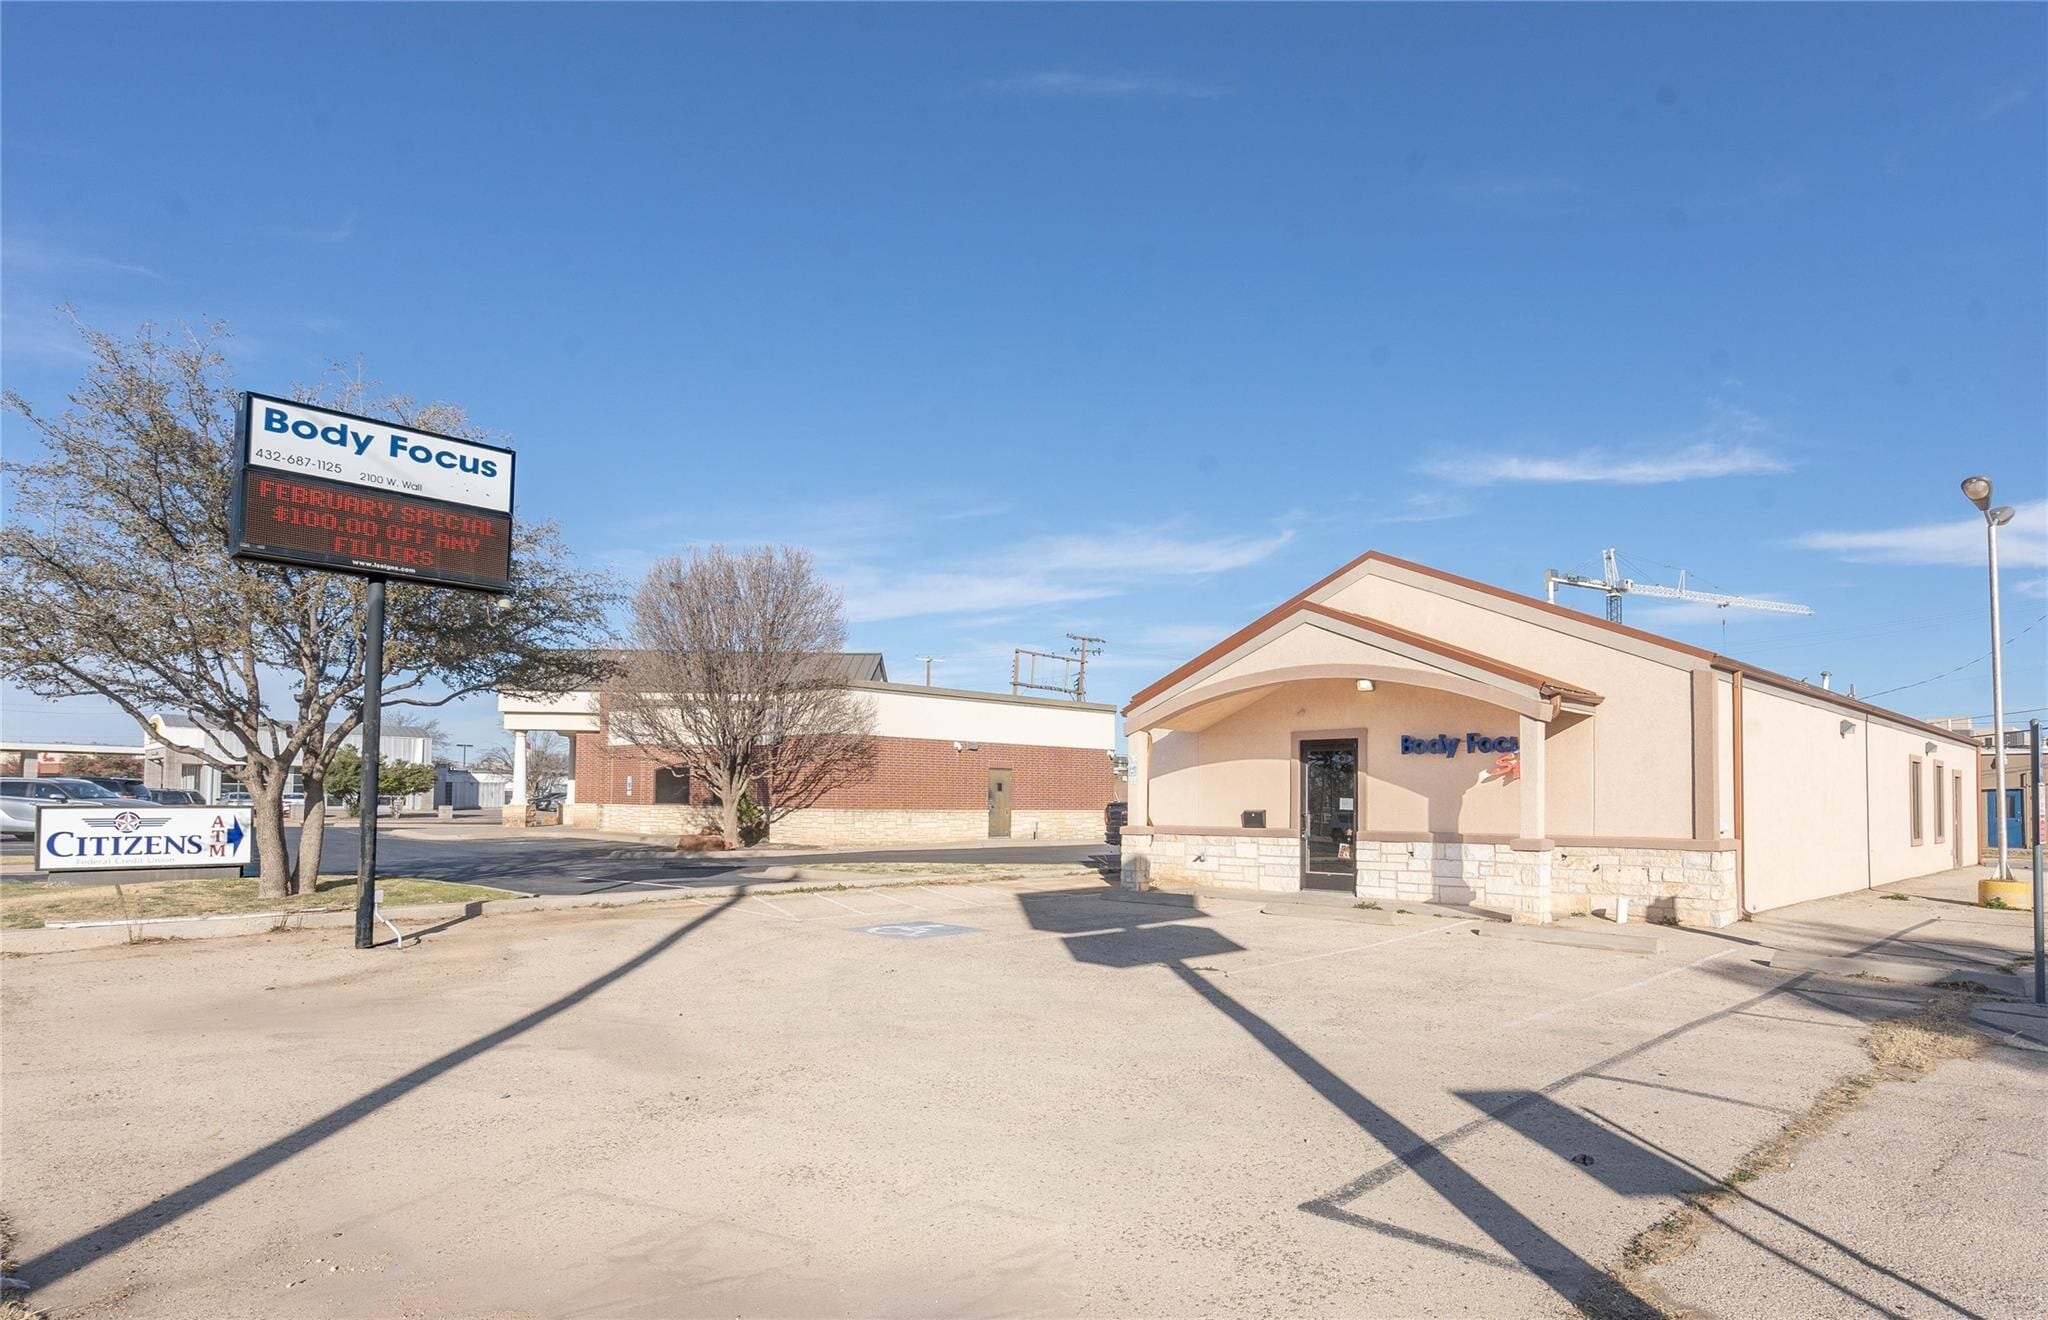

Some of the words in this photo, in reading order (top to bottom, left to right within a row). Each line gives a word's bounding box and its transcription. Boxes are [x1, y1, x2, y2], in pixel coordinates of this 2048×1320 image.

[264, 407, 375, 456] Body
[389, 434, 498, 478] Focus
[255, 448, 342, 474] 432-687-1125
[359, 472, 384, 485] 2100
[386, 477, 400, 488] W.
[401, 479, 423, 492] Wall
[259, 480, 393, 519] FEBRUARY
[401, 506, 496, 537] SPECIAL
[273, 504, 378, 537] $100.00
[386, 524, 427, 544] OFF
[436, 532, 480, 553] ANY
[333, 536, 434, 567] FILLERS
[1401, 733, 1461, 758] Body
